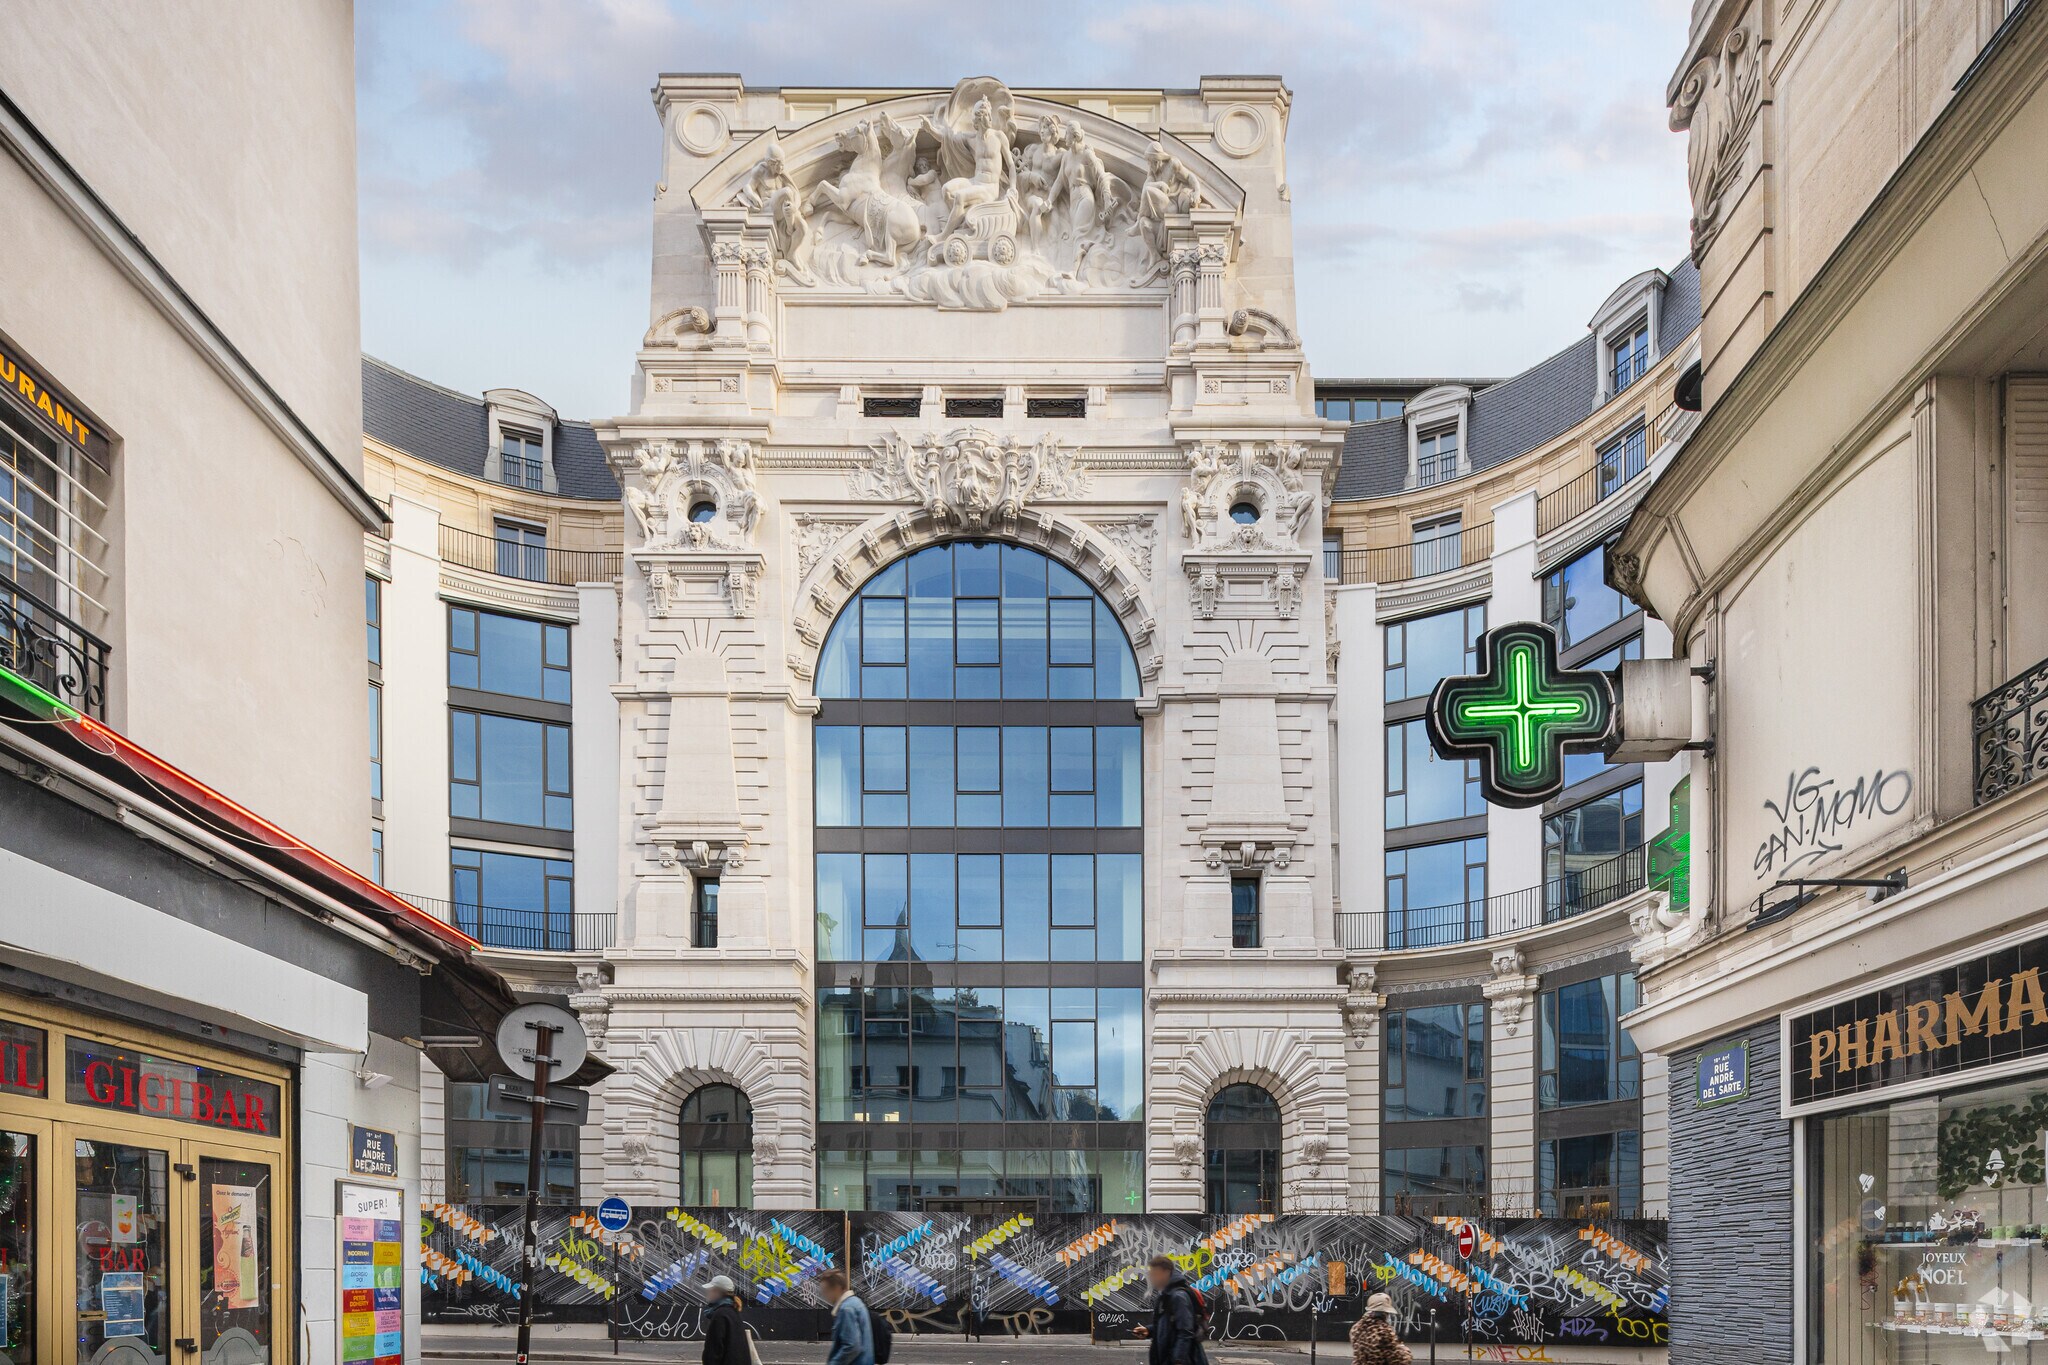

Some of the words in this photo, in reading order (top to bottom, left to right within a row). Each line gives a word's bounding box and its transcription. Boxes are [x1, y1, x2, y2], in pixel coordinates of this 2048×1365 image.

[1809, 966, 2048, 1080] PHARMA
[1714, 1061, 1730, 1074] RUE
[84, 1061, 268, 1132] GIGIBAR
[1703, 1088, 1717, 1099] DEL
[1718, 1080, 1742, 1095] SARTE
[366, 1139, 382, 1151] RUE
[361, 1149, 386, 1161] ANDRÉ
[370, 1161, 392, 1173] SARTE
[100, 1247, 145, 1272] BAR
[1919, 1252, 1968, 1267] JOYEUX
[1919, 1266, 1968, 1285] NOËL
